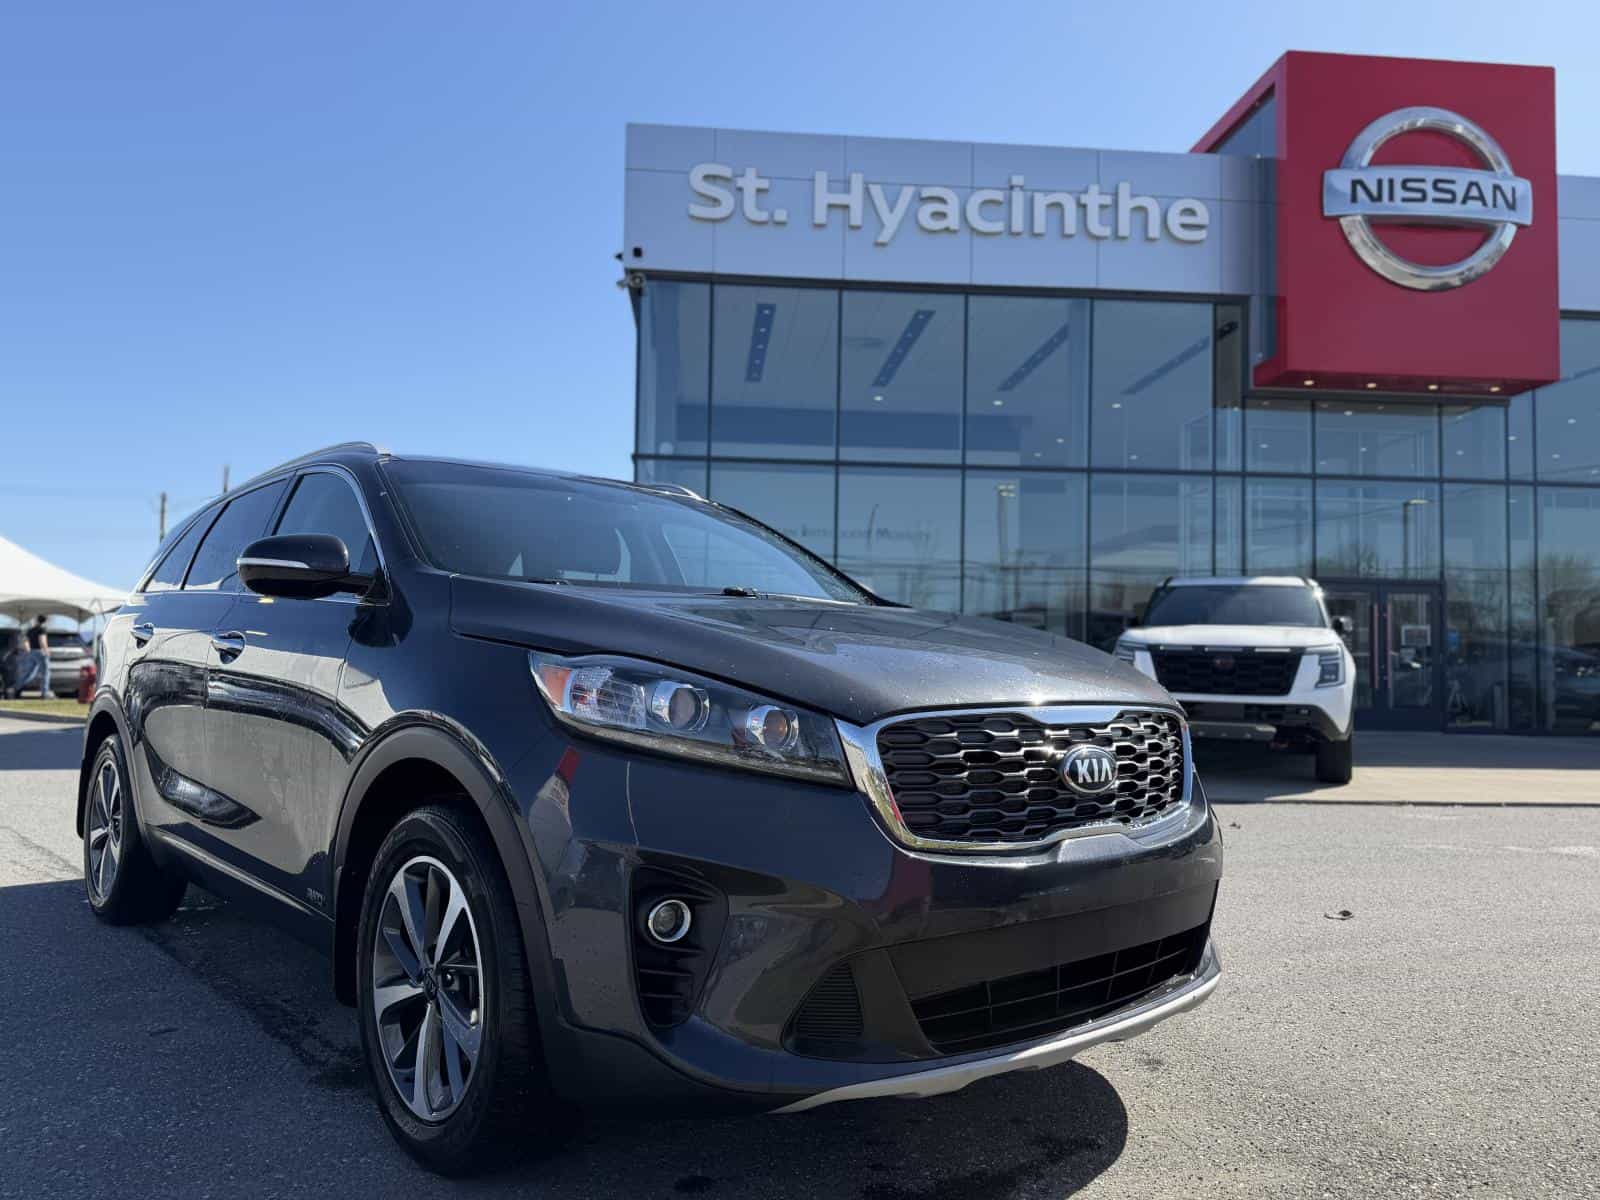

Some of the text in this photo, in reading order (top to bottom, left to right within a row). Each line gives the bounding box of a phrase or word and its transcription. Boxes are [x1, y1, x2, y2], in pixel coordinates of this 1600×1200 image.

[688, 162, 1209, 247] St. Hyacinthe
[1351, 177, 1517, 212] NISSAN
[1075, 758, 1113, 784] KIA
